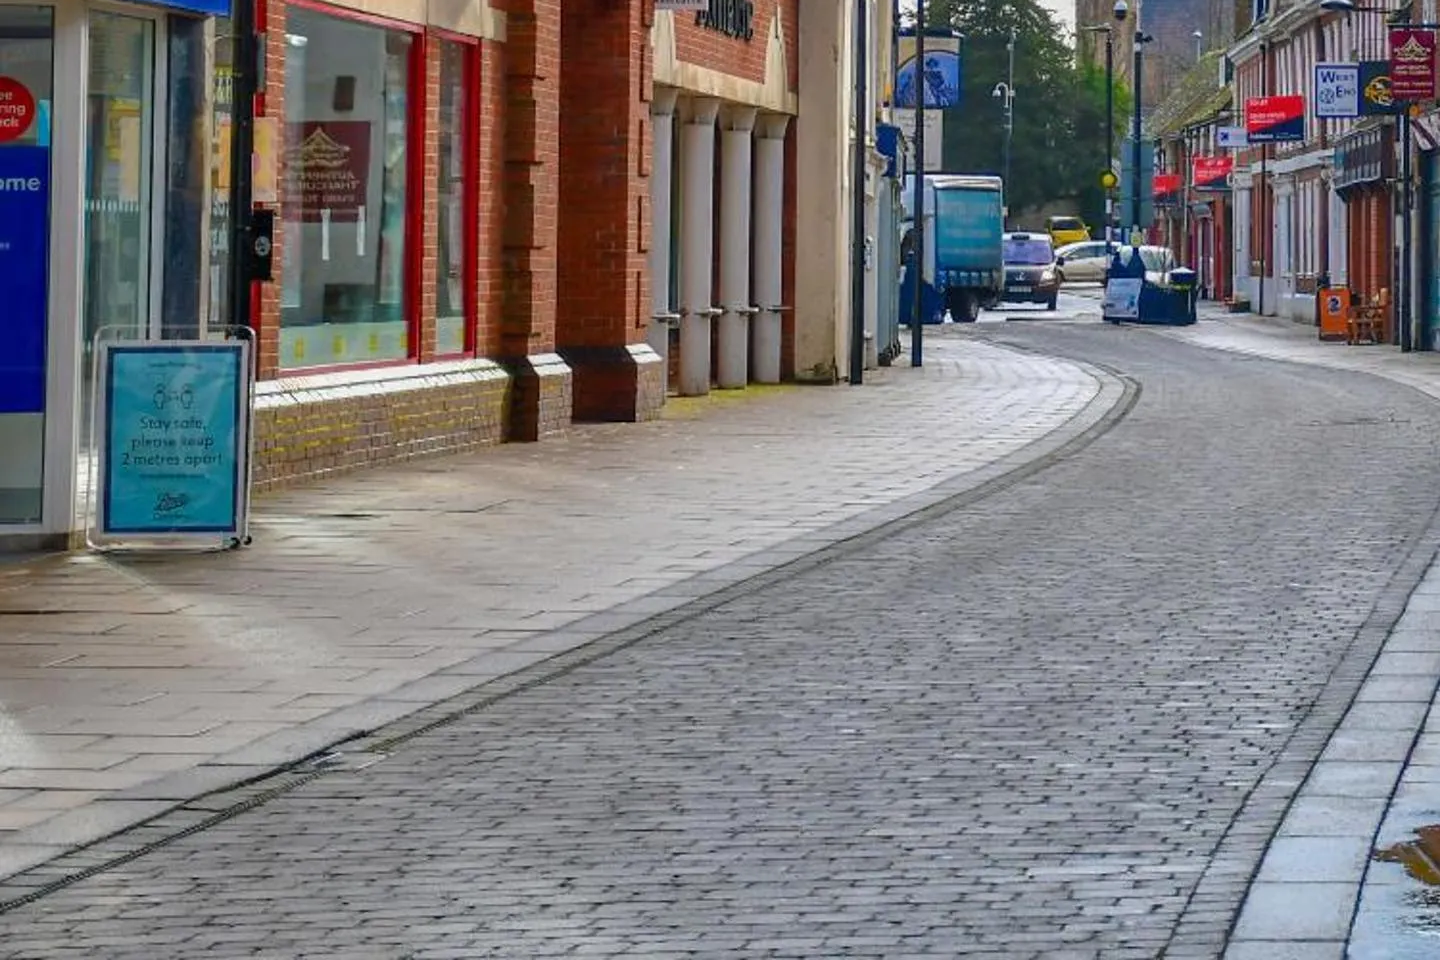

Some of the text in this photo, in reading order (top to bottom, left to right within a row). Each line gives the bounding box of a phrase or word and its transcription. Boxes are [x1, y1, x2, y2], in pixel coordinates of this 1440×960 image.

[140, 416, 207, 432] Stay safe,
[131, 434, 176, 451] please
[122, 453, 222, 468] 2 metres apart
